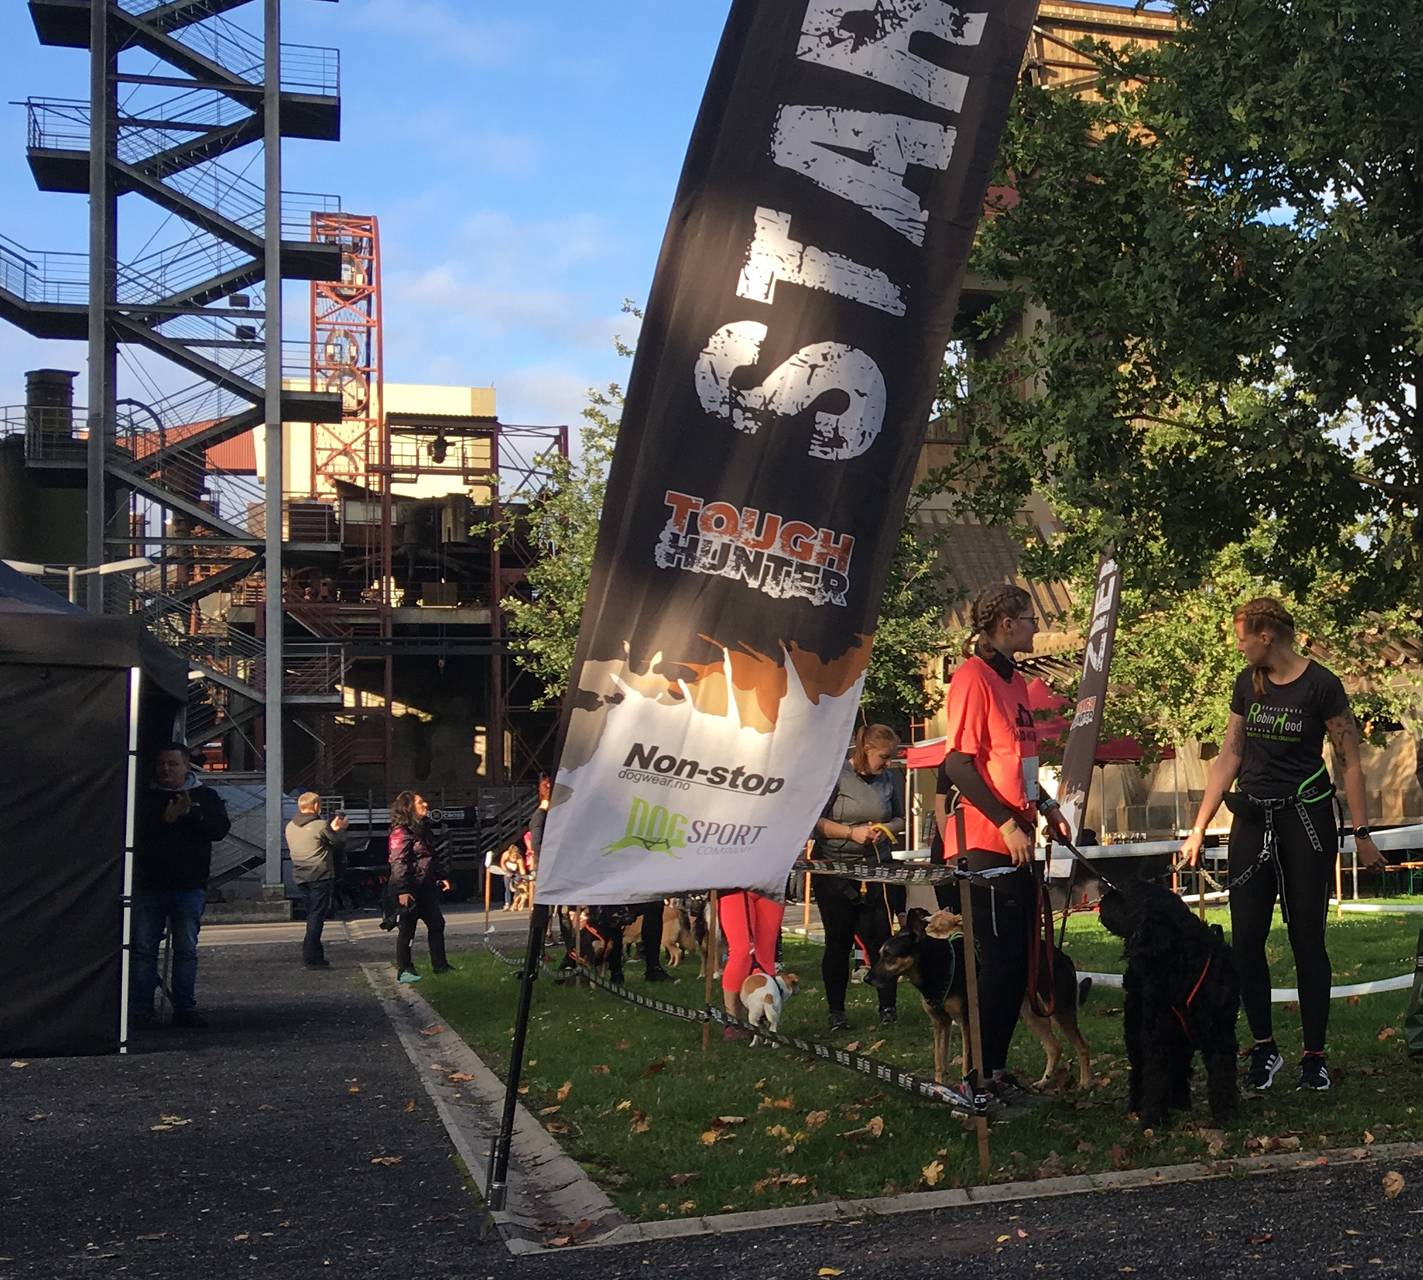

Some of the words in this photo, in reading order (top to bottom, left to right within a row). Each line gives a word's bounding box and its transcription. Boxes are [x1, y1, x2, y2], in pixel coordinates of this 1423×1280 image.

[664, 490, 855, 574] TOUGH
[656, 531, 850, 607] HUNTER
[1247, 703, 1275, 724] Robin
[1272, 713, 1302, 733] Hood
[618, 768, 691, 791] dogwear.no
[623, 743, 785, 796] Non-stop
[625, 795, 689, 848] DOG
[687, 820, 767, 846] SPORT
